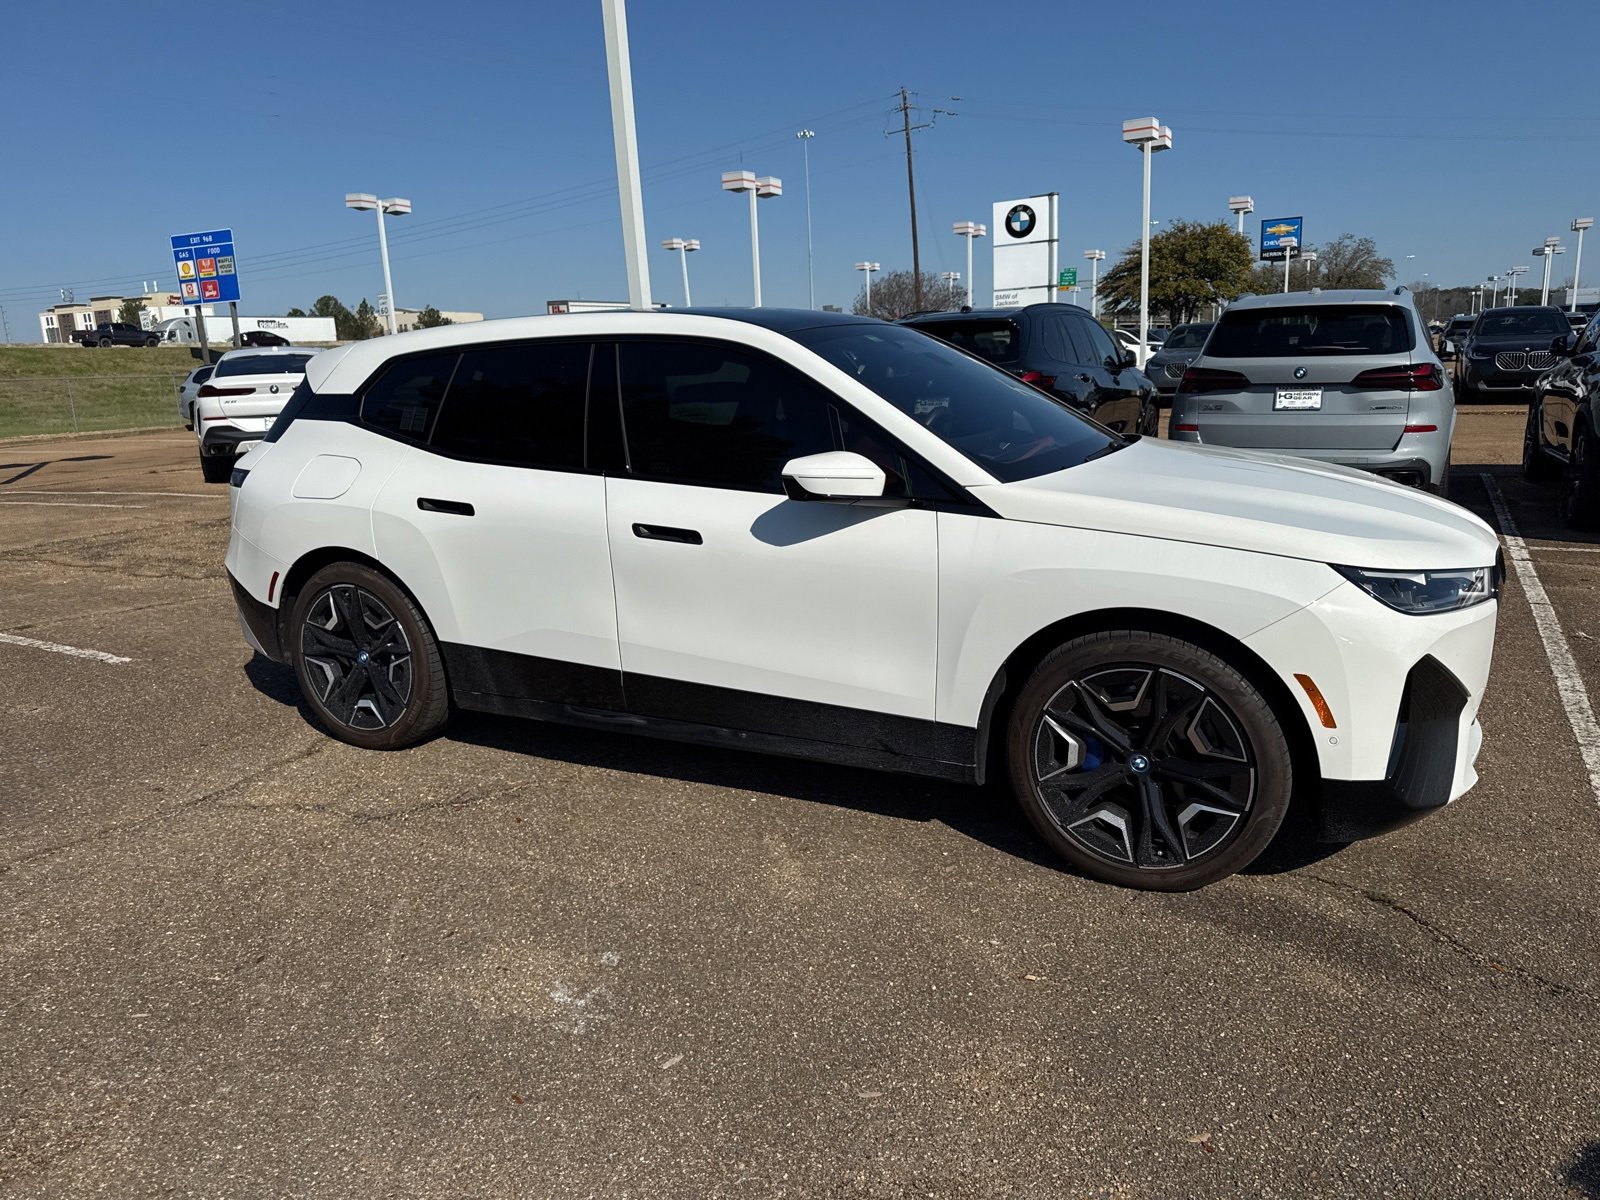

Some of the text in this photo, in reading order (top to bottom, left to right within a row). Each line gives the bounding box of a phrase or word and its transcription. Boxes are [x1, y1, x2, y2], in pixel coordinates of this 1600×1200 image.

[190, 236, 201, 244] EXIT
[178, 251, 189, 259] GAS
[207, 247, 221, 255] FOOD
